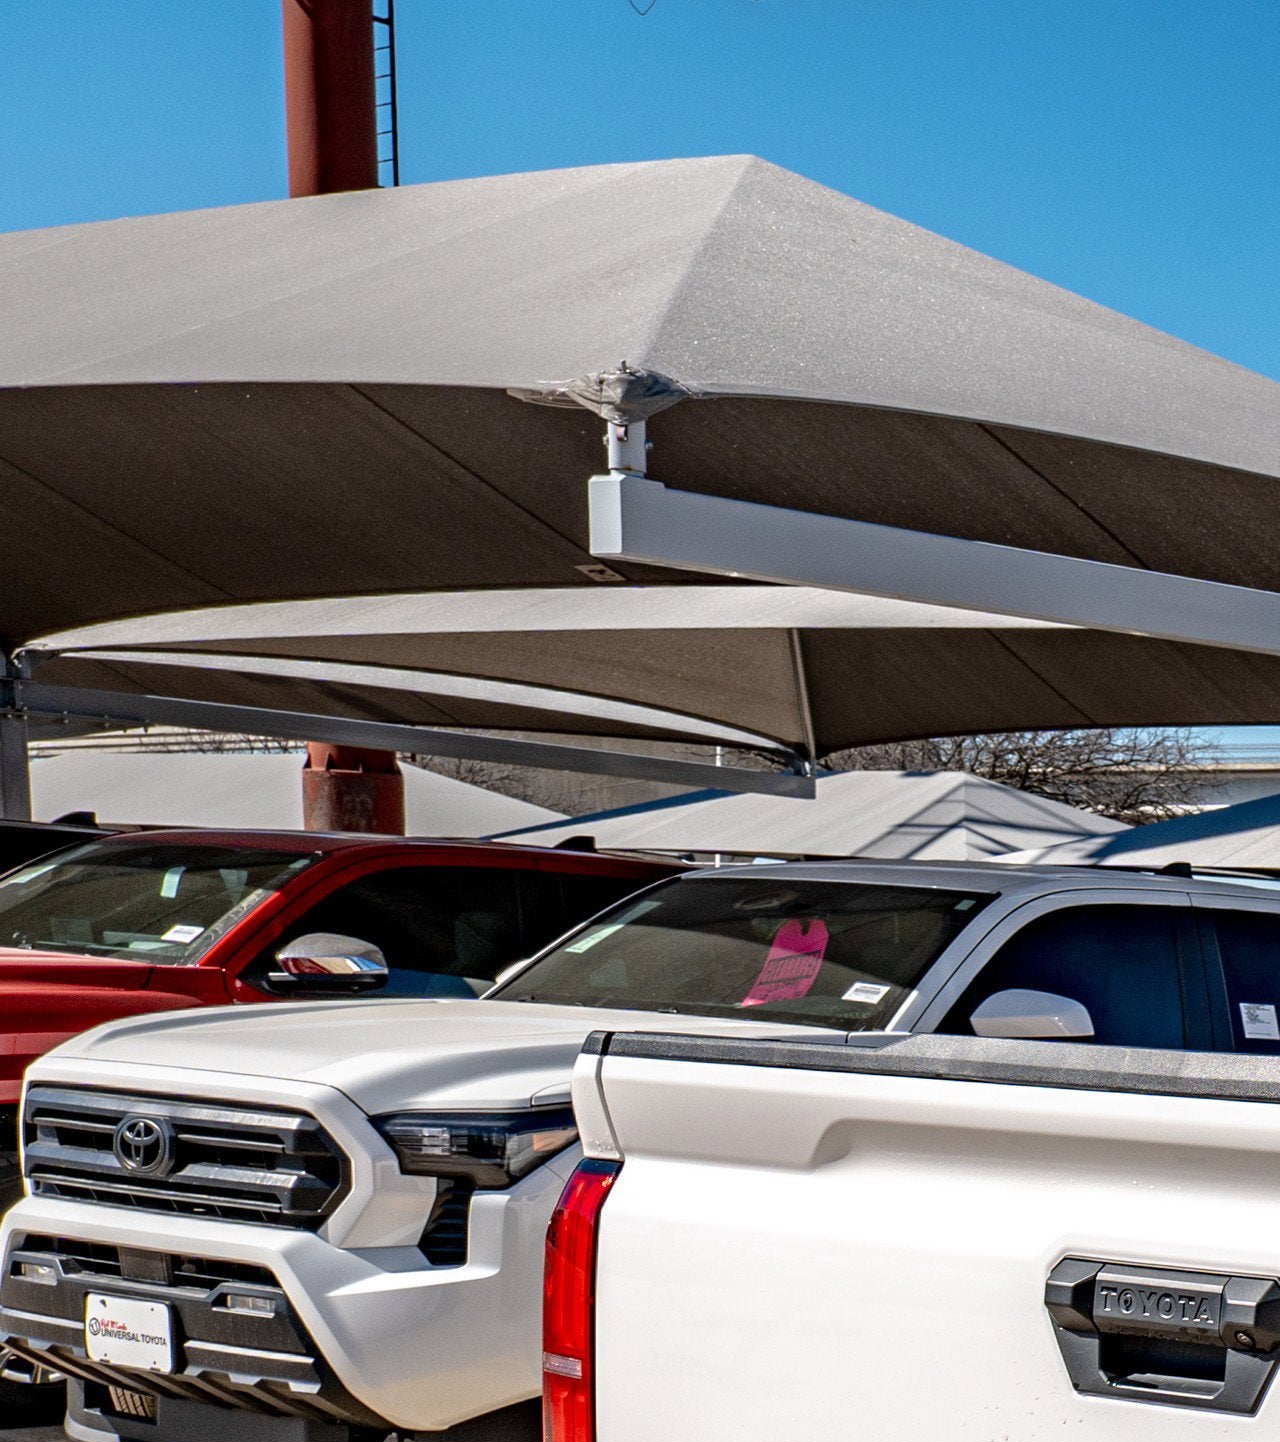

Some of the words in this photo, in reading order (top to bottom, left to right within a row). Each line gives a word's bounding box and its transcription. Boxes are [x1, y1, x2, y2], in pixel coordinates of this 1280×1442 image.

[1100, 1285, 1214, 1324] TOYOTA
[101, 1328, 140, 1342] UNIVERSAL
[141, 1333, 167, 1346] TOYOTA
